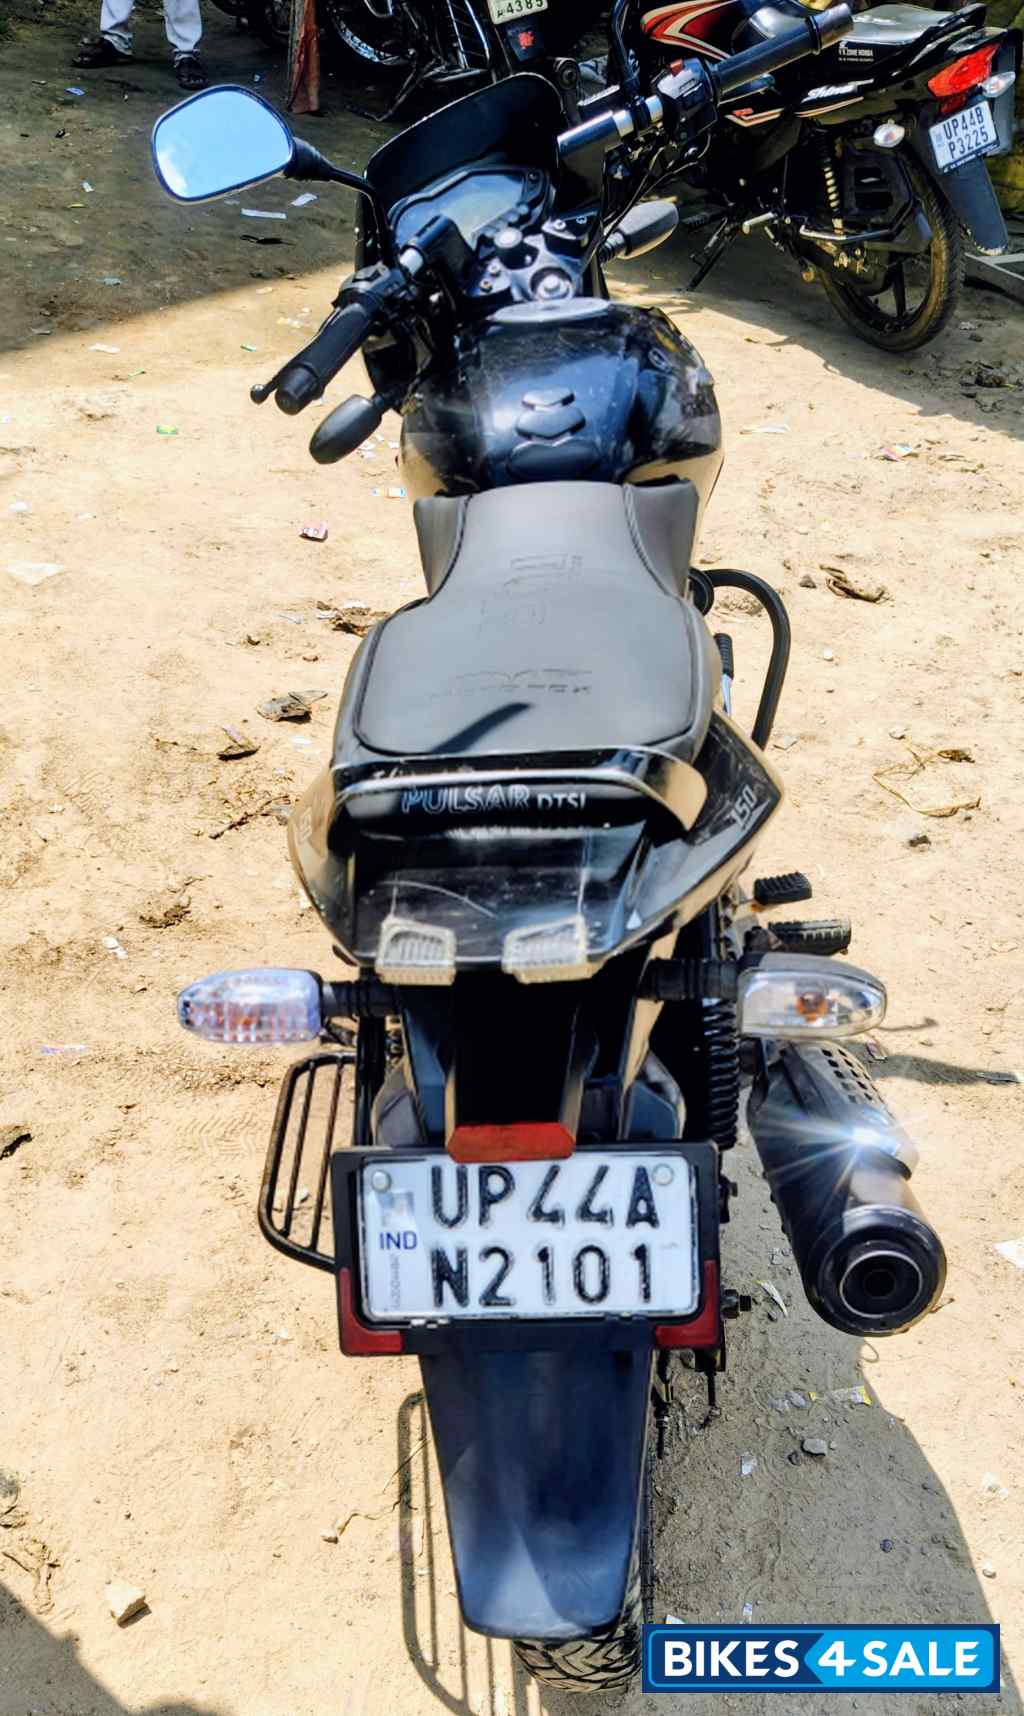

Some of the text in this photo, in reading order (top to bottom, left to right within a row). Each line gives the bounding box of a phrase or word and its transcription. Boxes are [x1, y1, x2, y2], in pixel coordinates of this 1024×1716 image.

[942, 106, 985, 140] UP44B
[947, 125, 989, 160] P3225
[402, 784, 531, 814] PULSAR
[723, 784, 758, 828] 150
[378, 1230, 418, 1250] IND
[430, 1243, 652, 1308] N2101
